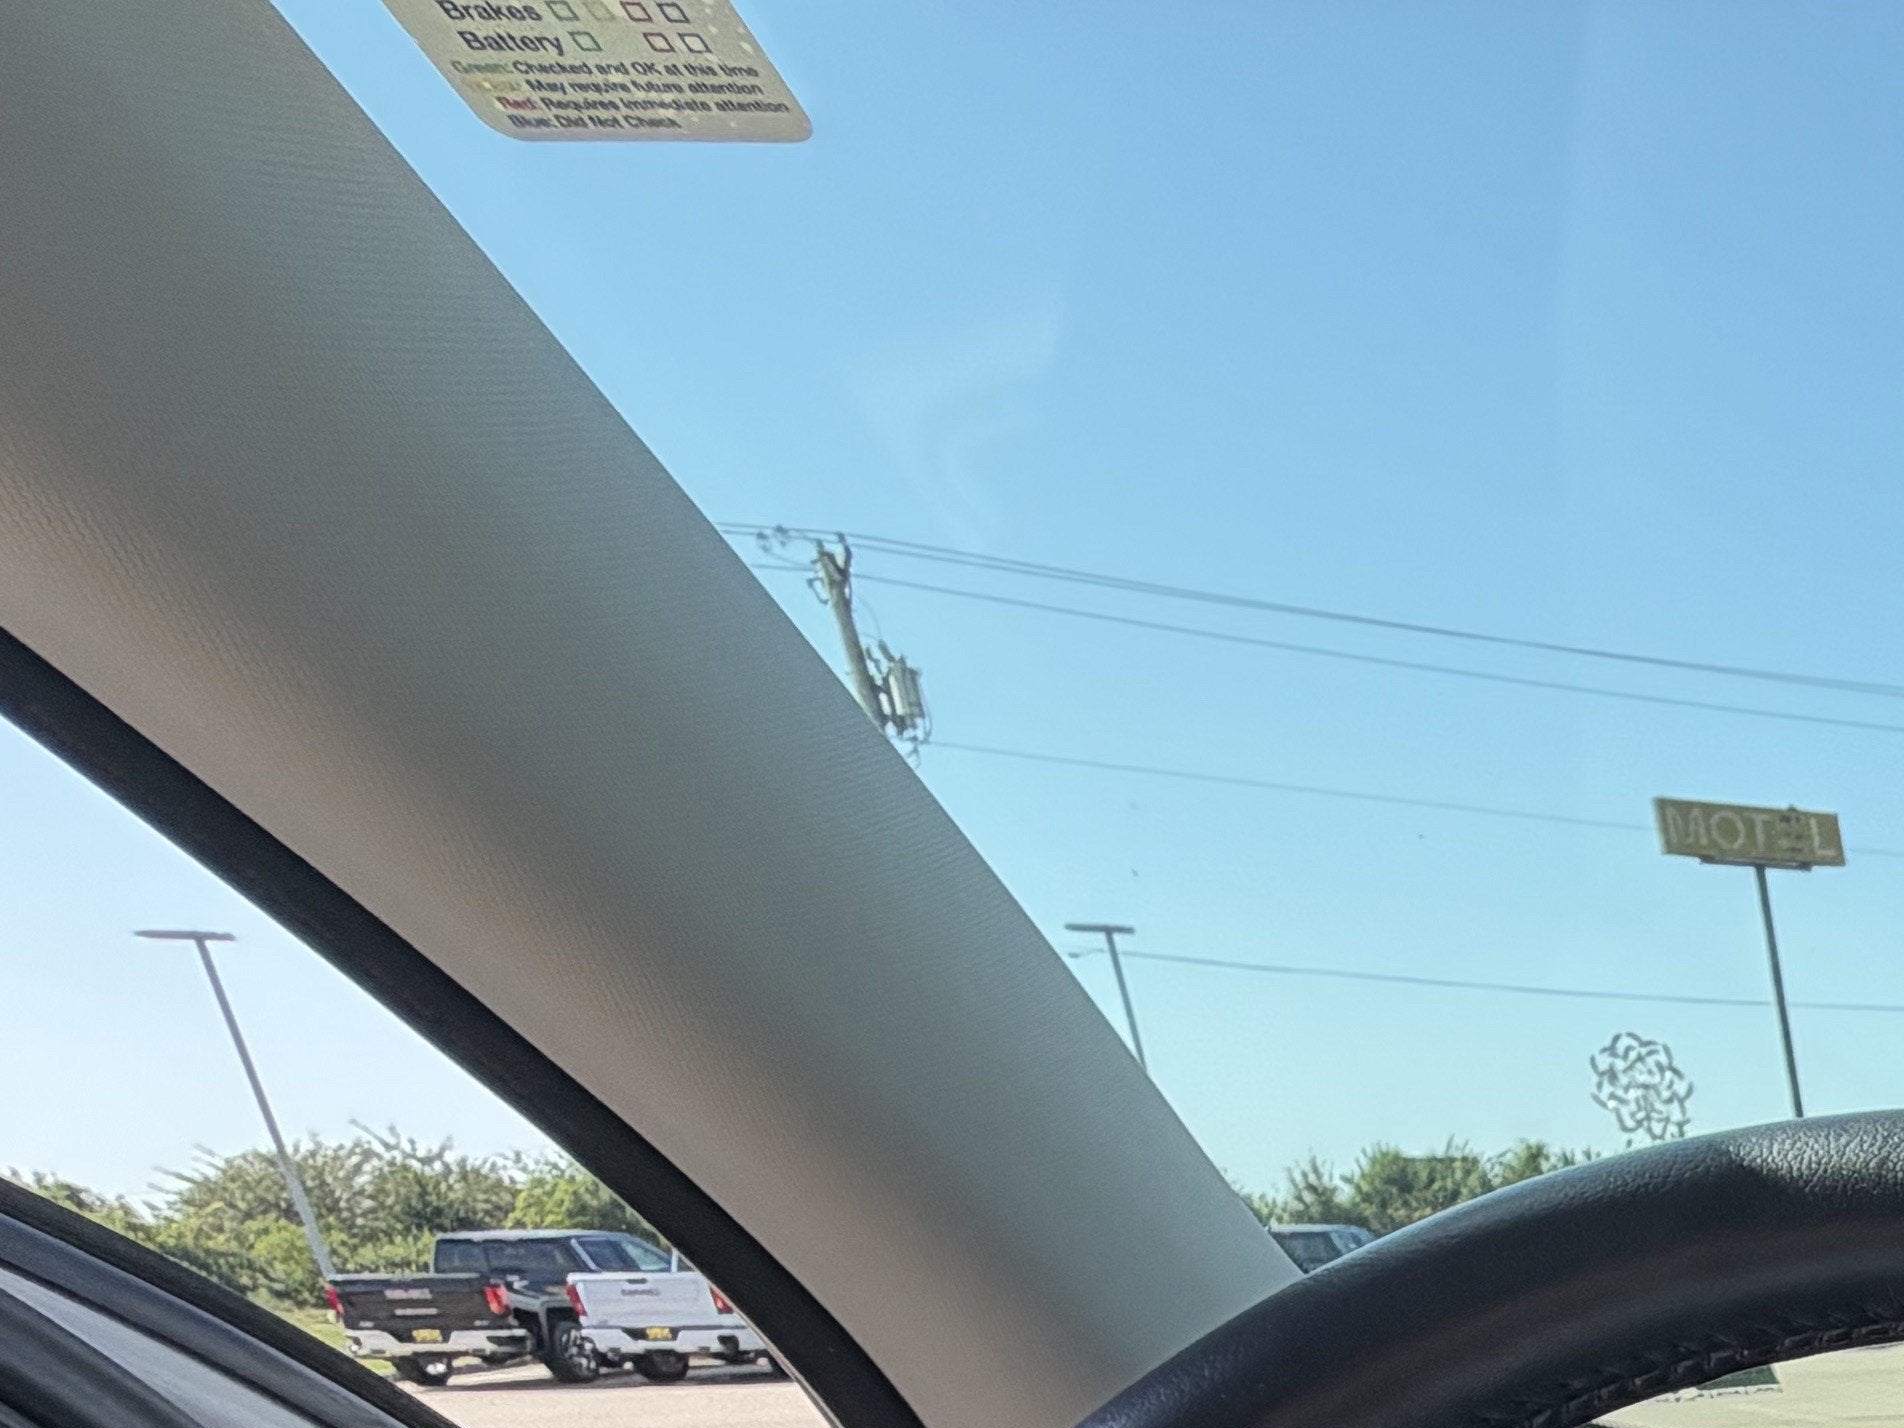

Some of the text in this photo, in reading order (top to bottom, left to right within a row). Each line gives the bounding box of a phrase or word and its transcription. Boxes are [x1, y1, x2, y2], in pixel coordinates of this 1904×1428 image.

[438, 0, 543, 21] Brakes
[457, 31, 565, 56] Battery
[513, 60, 593, 75] Checked
[594, 61, 630, 76] and
[630, 61, 663, 76] OK
[663, 63, 684, 77] at
[683, 62, 718, 77] this
[718, 63, 760, 77] time
[525, 79, 567, 95] May
[687, 81, 765, 95] attention
[714, 100, 791, 113] attention
